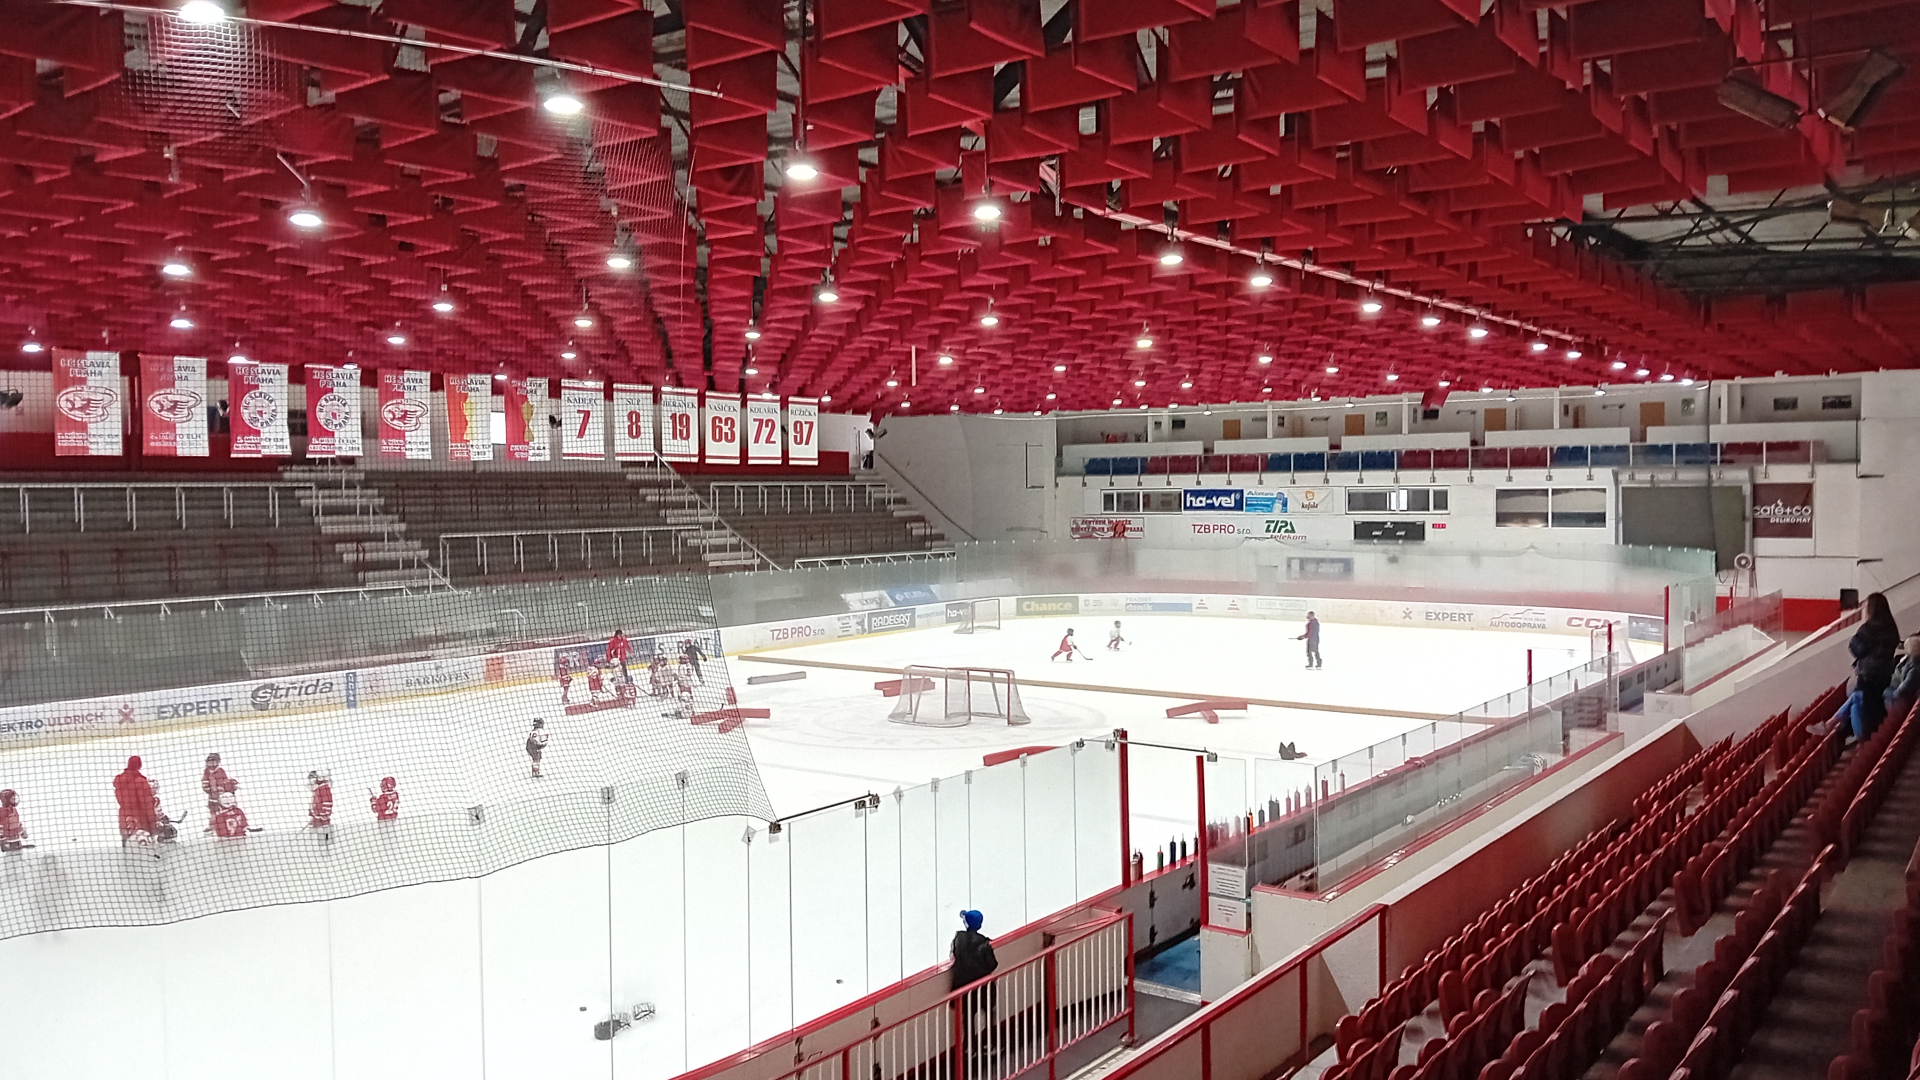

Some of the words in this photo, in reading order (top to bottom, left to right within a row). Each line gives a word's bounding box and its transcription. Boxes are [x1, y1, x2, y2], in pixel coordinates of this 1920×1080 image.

[236, 367, 250, 375] HC
[251, 368, 280, 376] SLAVIA
[326, 372, 354, 380] SLAVIA
[244, 376, 274, 384] PRAHA
[320, 380, 347, 388] PRAHA
[397, 376, 424, 384] SLAVIA
[249, 392, 274, 404] SLAVIA
[260, 408, 277, 427] PRAHA
[576, 410, 590, 438] 7
[628, 410, 642, 439] 8
[670, 412, 690, 440] 19
[712, 416, 736, 443] 63
[752, 418, 776, 444] 72
[793, 420, 814, 446] 97
[1191, 524, 1211, 534] TZB
[1212, 524, 1236, 534] PRO
[1265, 520, 1296, 534] TIPA
[1022, 601, 1072, 612] Chance
[872, 613, 912, 626] RADEGAST
[1425, 611, 1474, 622] EXPERT
[1566, 616, 1621, 630] CCM
[1490, 621, 1546, 630] AUTODOPRAVA
[770, 628, 789, 641] TZB
[791, 626, 812, 638] PRO
[157, 698, 233, 720] EXPERT
